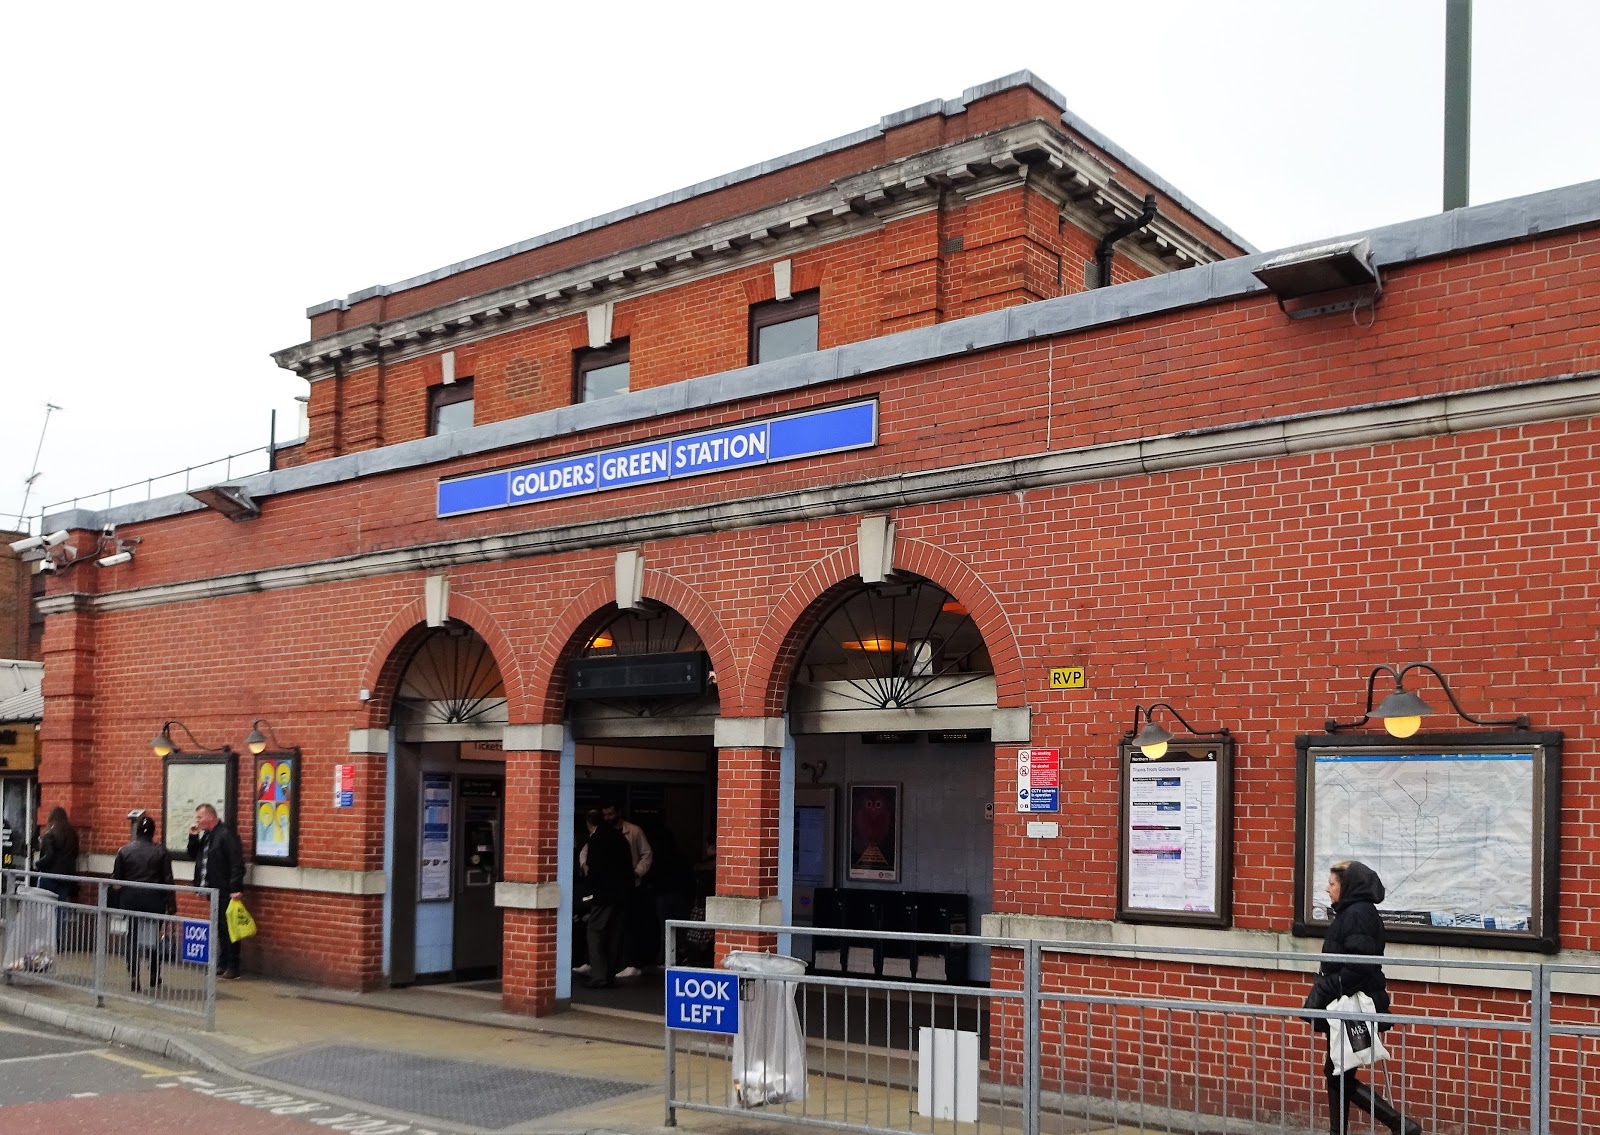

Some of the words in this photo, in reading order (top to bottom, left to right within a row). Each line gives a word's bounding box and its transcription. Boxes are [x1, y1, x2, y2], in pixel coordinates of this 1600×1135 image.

[511, 462, 596, 497] GOLDERS
[602, 448, 667, 480] GREEN
[675, 430, 766, 469] STATION
[1053, 671, 1083, 686] RVP
[474, 742, 503, 752] Tickets
[185, 925, 207, 941] LOOK
[186, 942, 206, 958] LEFT
[675, 978, 730, 1001] LOOK
[680, 1003, 725, 1025] LEFT
